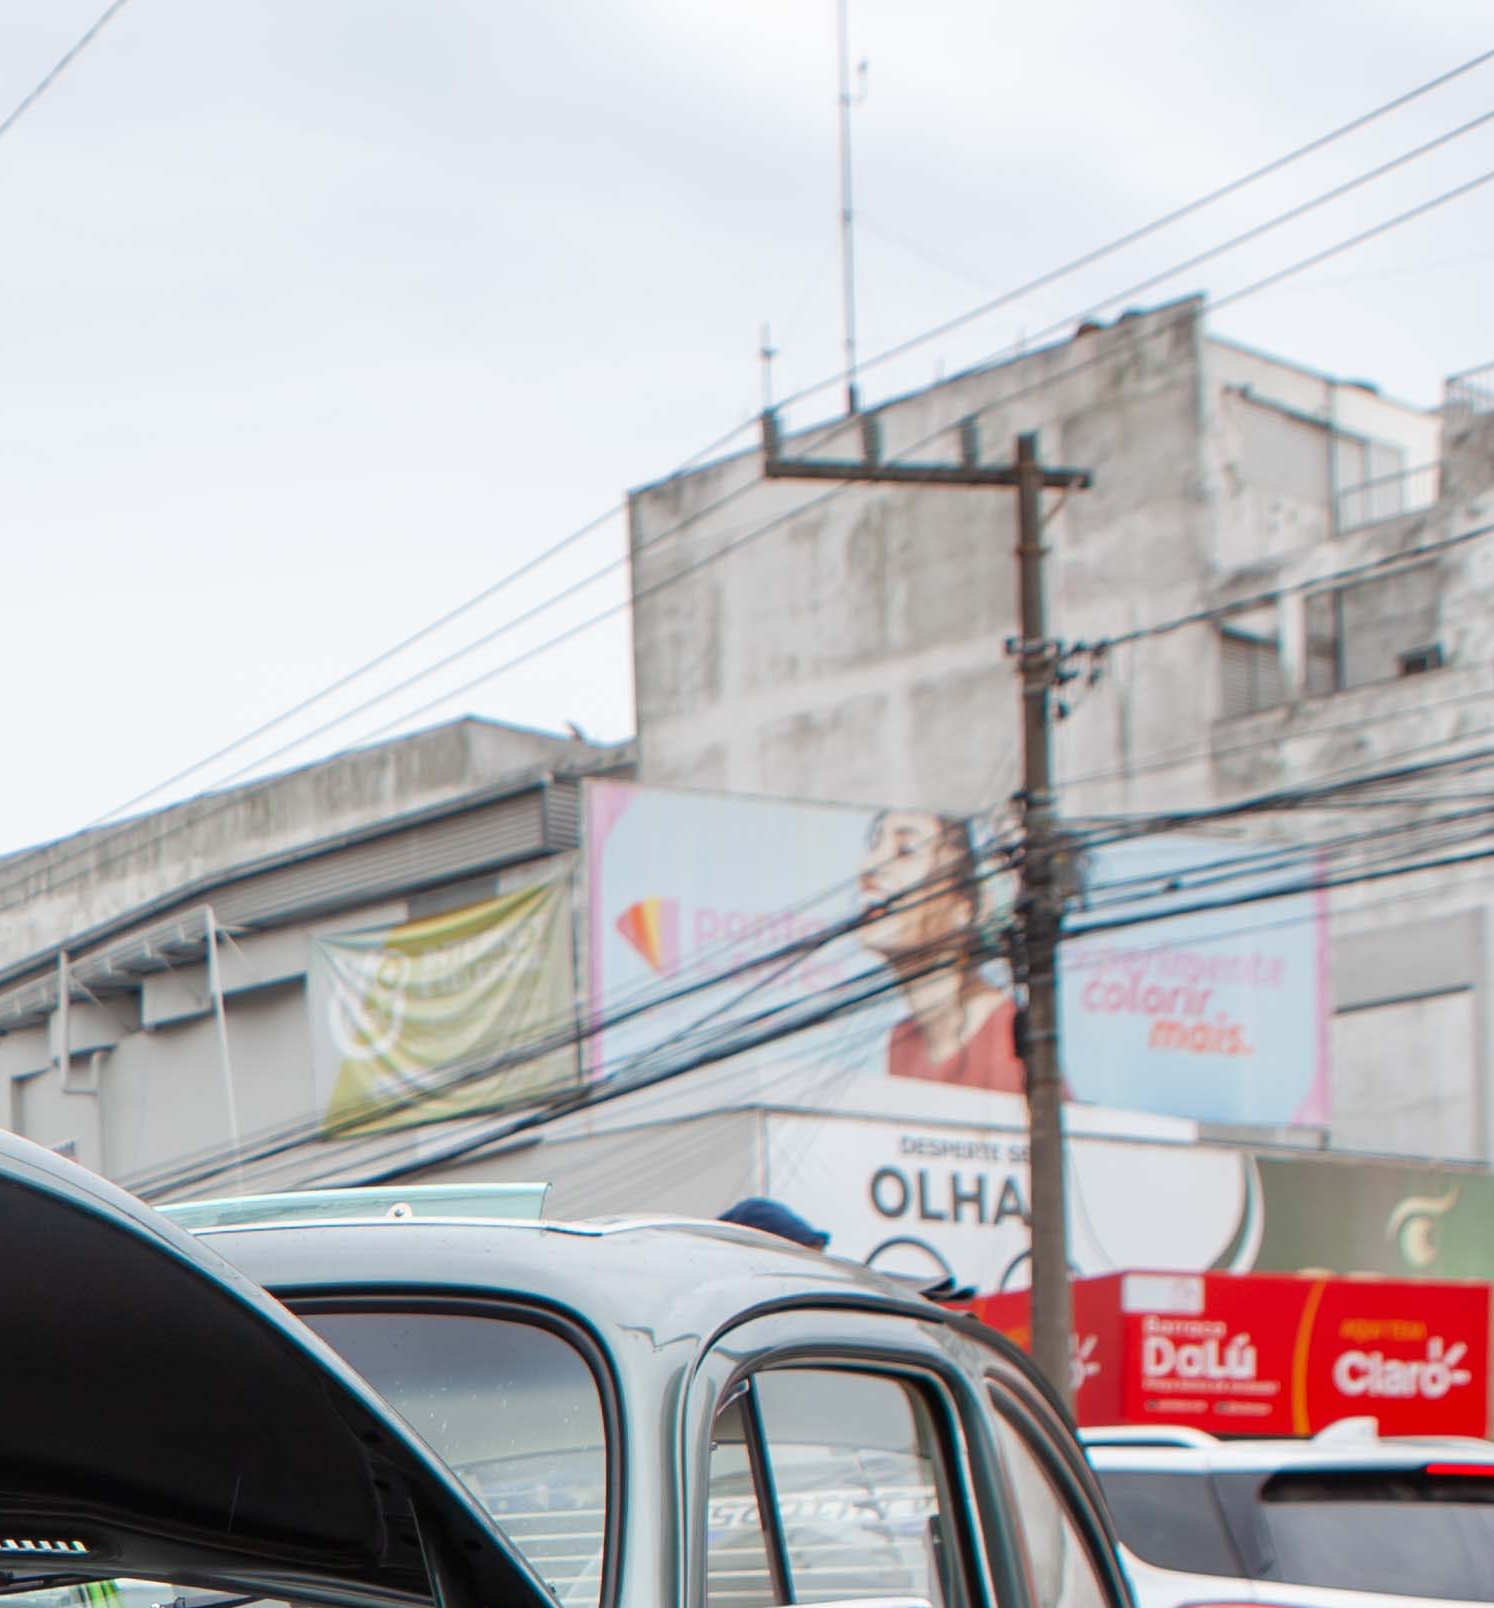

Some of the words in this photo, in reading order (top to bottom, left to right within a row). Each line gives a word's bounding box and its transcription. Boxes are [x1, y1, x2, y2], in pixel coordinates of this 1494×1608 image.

[1081, 969, 1215, 1016] colorir
[899, 1134, 1000, 1162] DESPERTE
[870, 1165, 1031, 1227] OLHA
[1332, 1346, 1456, 1400] Claro
